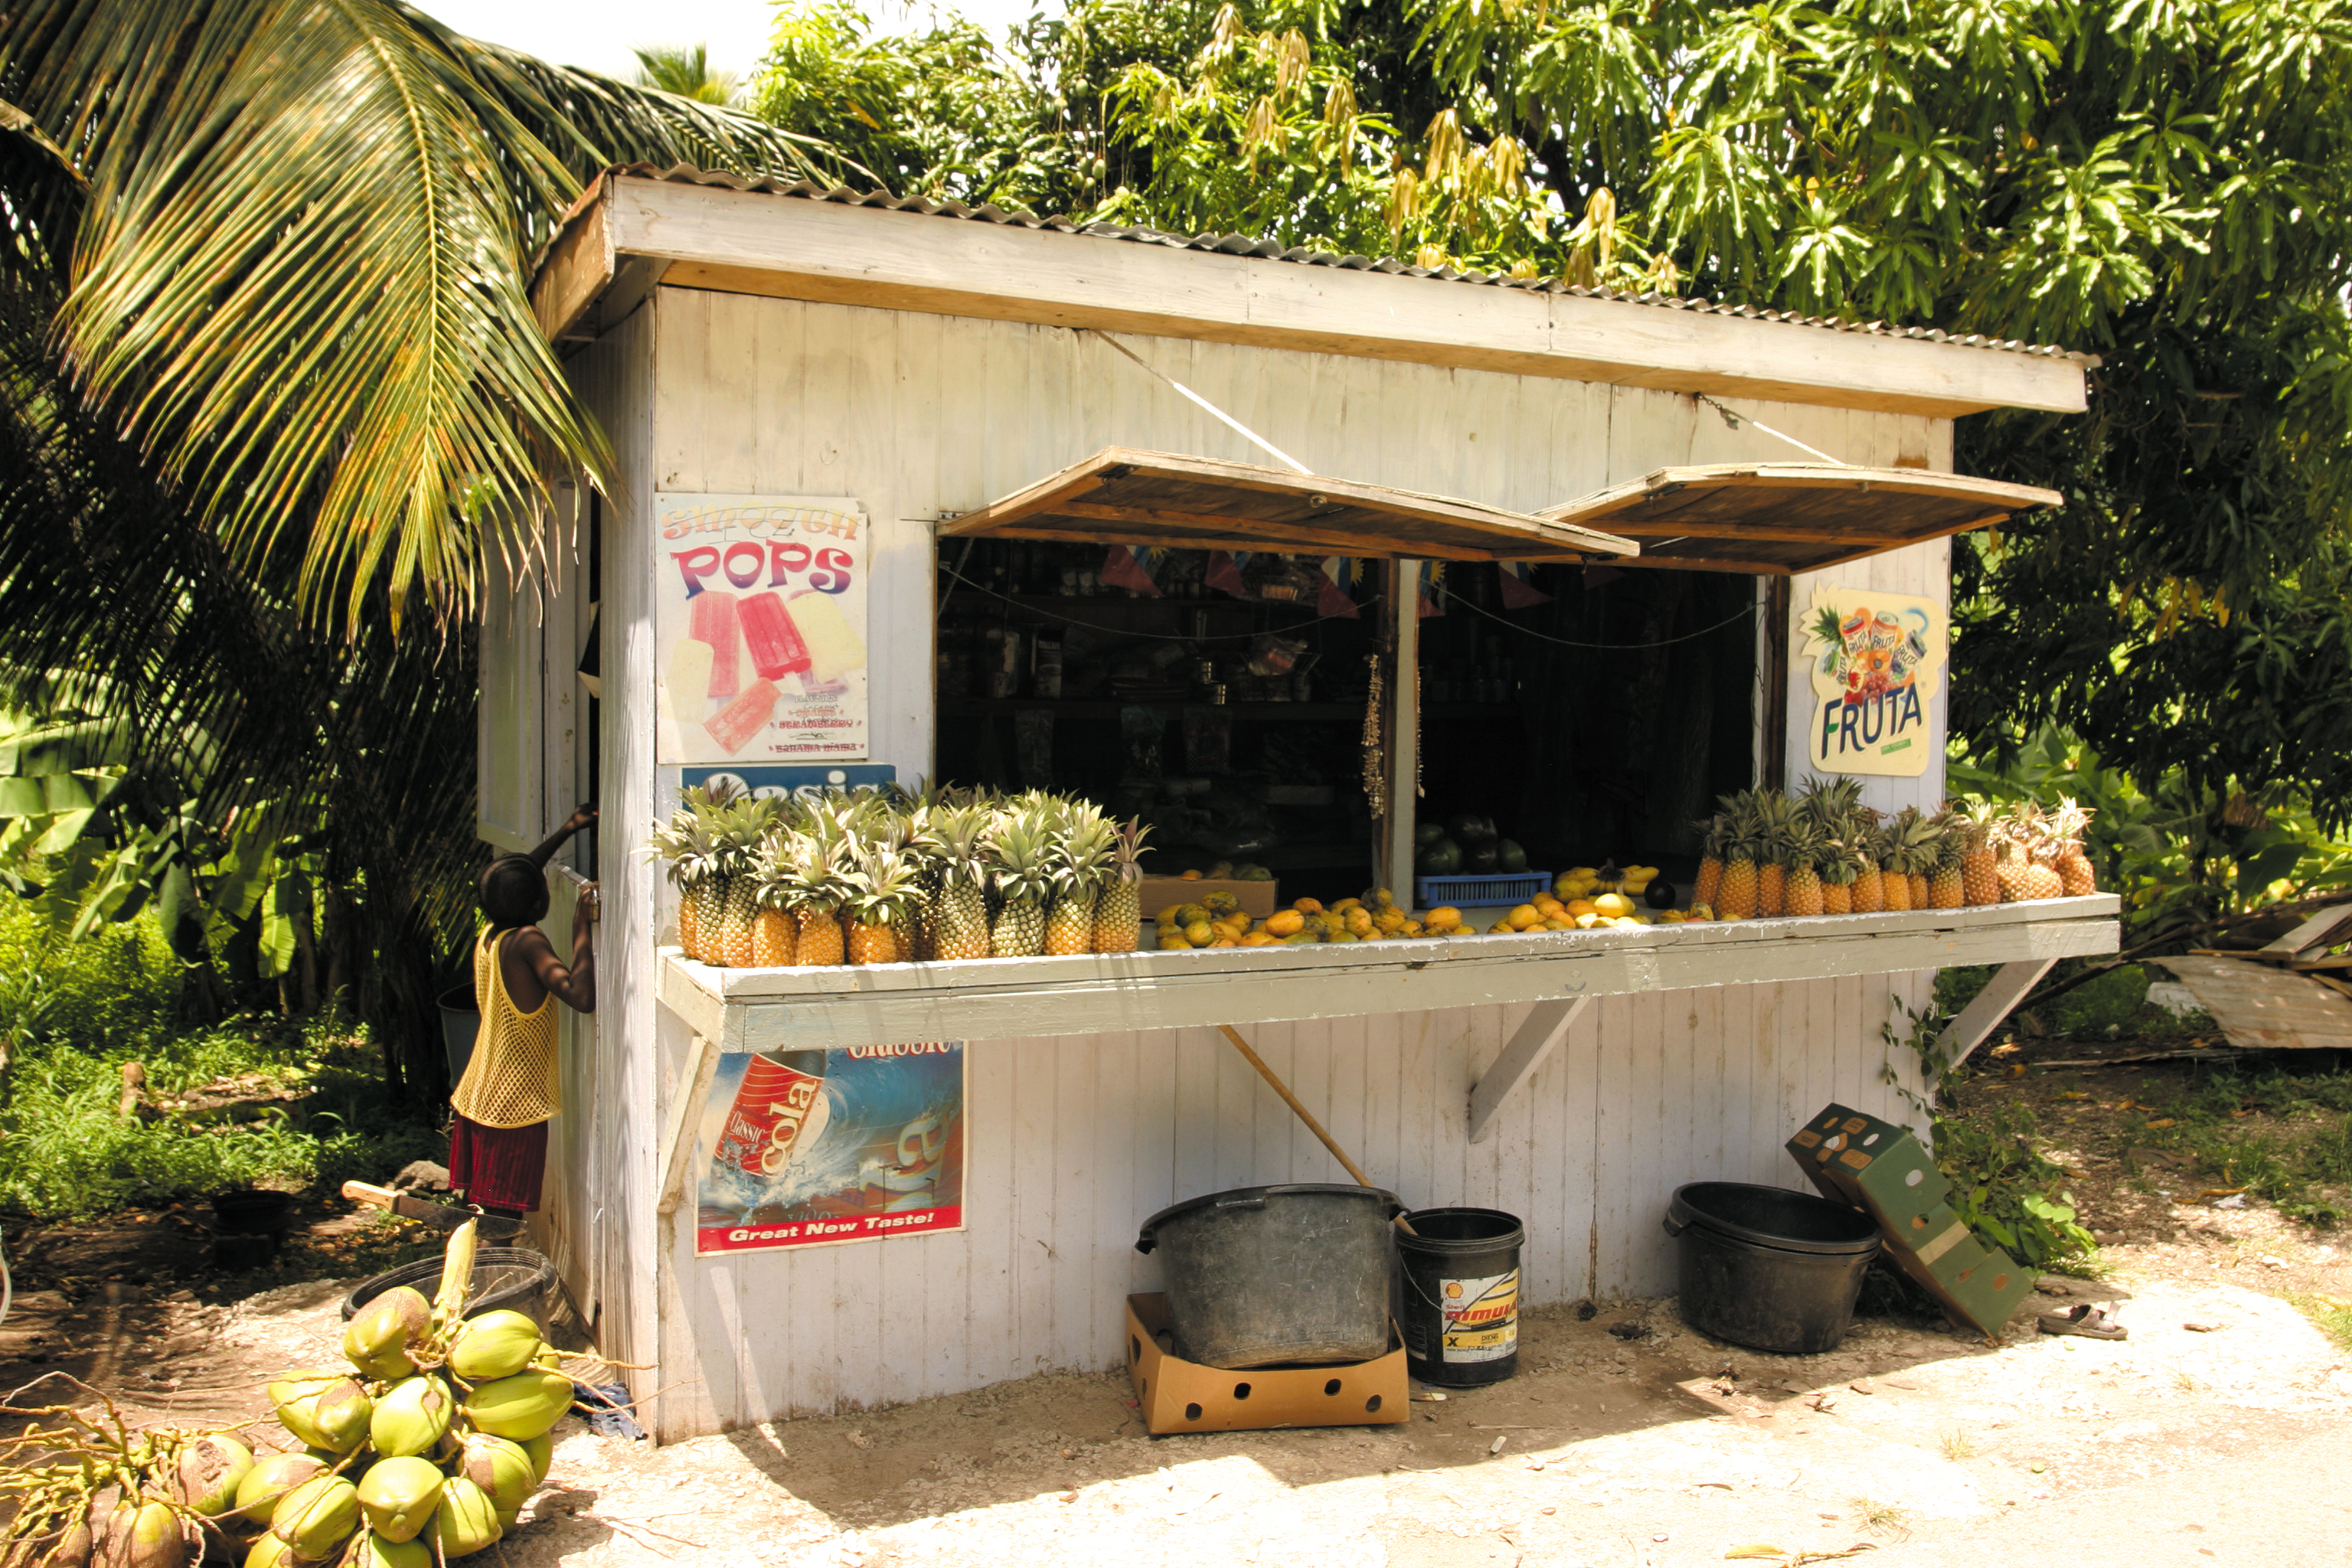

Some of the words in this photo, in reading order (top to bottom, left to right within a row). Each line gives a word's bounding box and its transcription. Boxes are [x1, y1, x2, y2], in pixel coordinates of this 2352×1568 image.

[669, 537, 854, 600] POPS
[1870, 635, 1896, 650] FRUTA
[1897, 644, 1919, 666] FRUTA
[1821, 682, 1922, 760] FRUTA
[730, 1111, 766, 1144] Classic
[729, 1226, 799, 1243] Great
[805, 1221, 858, 1236] New
[864, 1213, 935, 1230] Taste!
[1447, 1337, 1459, 1347] X
